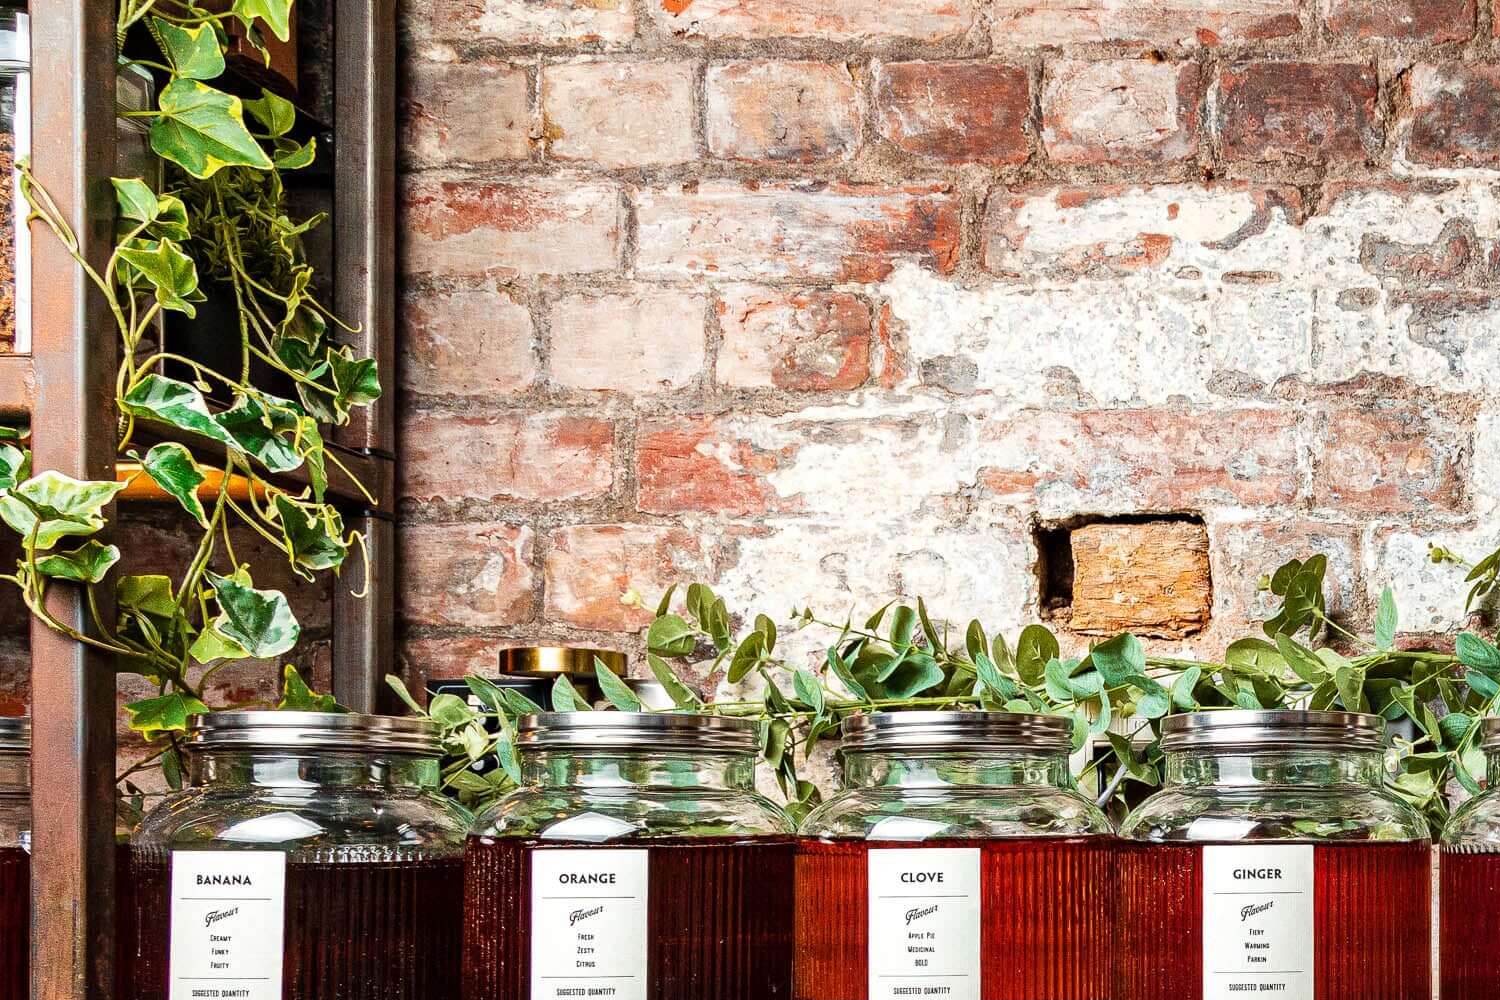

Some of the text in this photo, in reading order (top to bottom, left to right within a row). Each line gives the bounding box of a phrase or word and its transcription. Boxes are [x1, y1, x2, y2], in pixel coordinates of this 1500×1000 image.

[559, 874, 616, 884] ORANGE
[901, 873, 944, 883] CLOVE
[1233, 869, 1282, 880] GINGER
[196, 875, 252, 886] BANANA
[569, 905, 604, 926] Flavour
[905, 904, 938, 925] Flavour
[1241, 900, 1273, 921] Flavour
[205, 906, 239, 928] Flavour
[556, 988, 616, 996] SUGGESTED QUANTITY
[894, 987, 950, 995] SUGGESTED QUANTITY
[1229, 983, 1285, 992] SUGGESTED QUANTITY
[222, 989, 249, 998] QUANTITY
